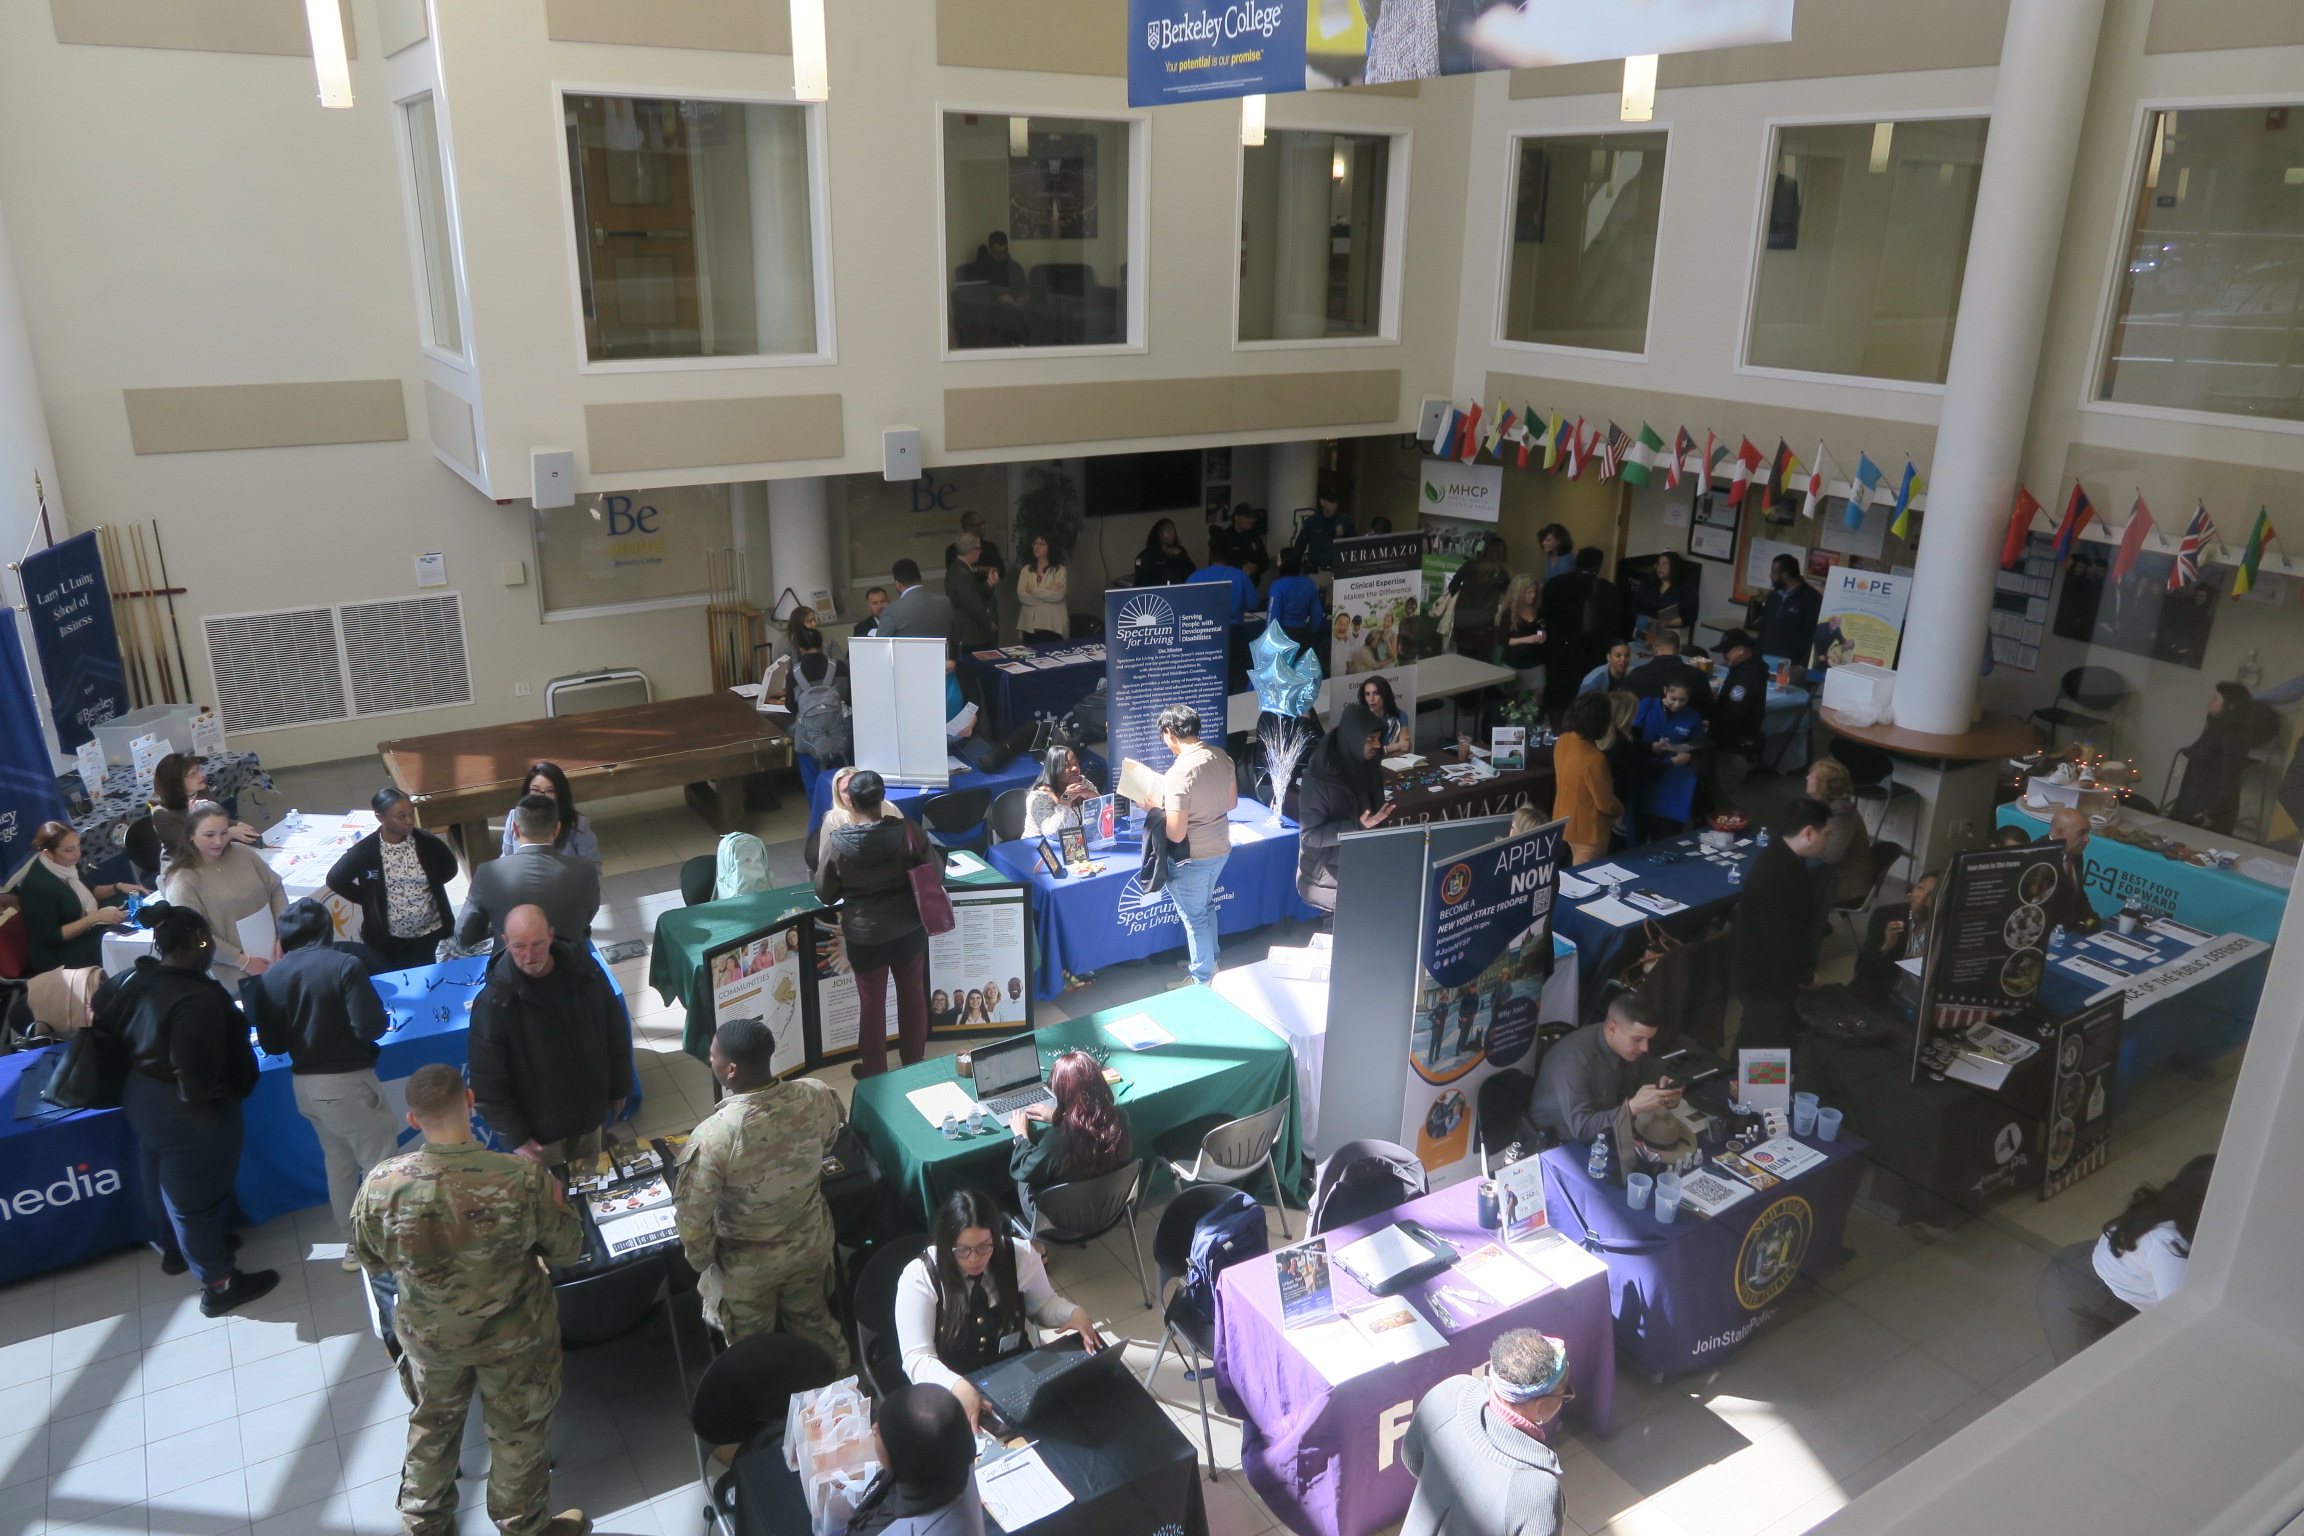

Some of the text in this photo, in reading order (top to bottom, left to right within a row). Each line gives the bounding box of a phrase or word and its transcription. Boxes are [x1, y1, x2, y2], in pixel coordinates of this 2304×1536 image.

[1161, 1, 1282, 49] Berkeley College
[1164, 60, 1178, 74] Your
[1178, 55, 1211, 74] potential
[1212, 54, 1218, 66] is
[1218, 56, 1230, 66] our
[1448, 484, 1489, 498] MHCP
[603, 496, 660, 536] Be
[1340, 544, 1417, 562] VERAMAZO
[36, 588, 59, 605] Larry
[70, 572, 94, 590] Luing
[1350, 578, 1406, 590] Clinical Expertise
[79, 592, 89, 607] of
[1344, 592, 1365, 600] Makes
[1378, 587, 1412, 596] Difference
[1182, 614, 1202, 622] Serving
[1182, 620, 1200, 628] People
[1116, 626, 1172, 640] Spectrum
[1182, 626, 1222, 634] Developmental
[1182, 634, 1212, 642] Disabilities
[1126, 636, 1174, 650] for Living
[1494, 833, 1558, 875] APPLY
[1510, 862, 1554, 895] NOW
[2122, 872, 2180, 900] BEST FOOT
[2118, 881, 2177, 911] FORWARD
[1438, 894, 1528, 934] NEW YORK STATE TROOPER
[1440, 899, 1476, 920] BECOME A
[1127, 912, 1180, 936] for Living
[1435, 937, 1471, 956] #JoinNYSP
[2141, 982, 2155, 992] OF
[2152, 972, 2179, 988] THE
[2177, 960, 2211, 980] PUBLIC
[2208, 938, 2256, 962] DEFENDER
[718, 972, 770, 1000] COMMUNITIES
[832, 978, 852, 988] JOIN
[1498, 1004, 1528, 1020] Why Join?
[1764, 1156, 1792, 1172] FOLLOW
[1754, 1200, 1806, 1236] NEW YORK
[982, 1468, 999, 1479] Sign
